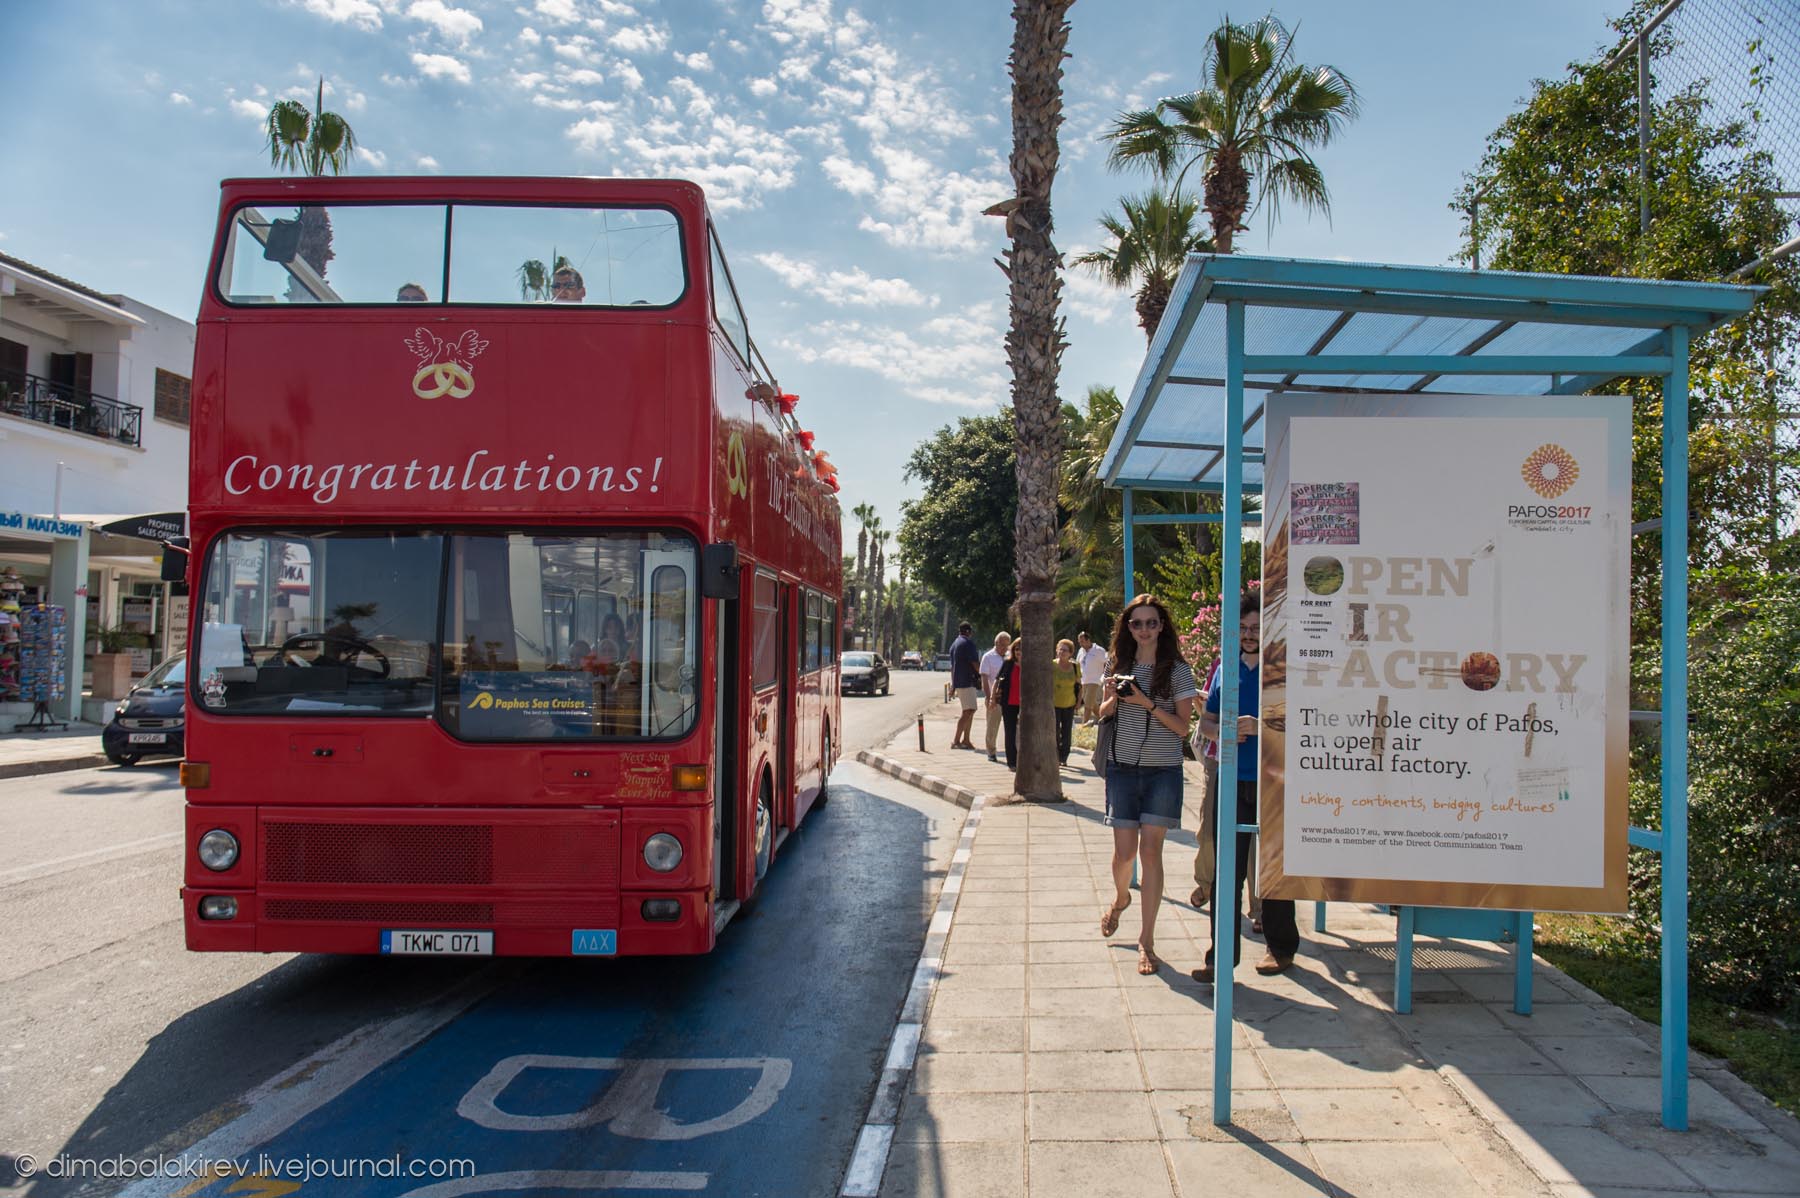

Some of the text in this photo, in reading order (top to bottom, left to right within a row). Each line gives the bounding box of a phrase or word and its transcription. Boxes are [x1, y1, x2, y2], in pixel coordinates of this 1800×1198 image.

[225, 449, 662, 504] Congratulations!
[1508, 505, 1591, 518] PAFOS2017
[27, 517, 82, 537] МАГАЗИН
[138, 526, 157, 538] SALES
[148, 519, 180, 532] PROPERTY
[1303, 555, 1474, 597] OPEN
[1315, 600, 1332, 608] RENT
[1299, 649, 1308, 657] 96
[495, 697, 585, 710] Paphos Sea Cruises
[1300, 708, 1558, 736] The whole city of Pafos,
[1300, 733, 1422, 753] an open air
[1300, 752, 1471, 779] cultural factory.
[1351, 794, 1427, 812] continents,
[1433, 796, 1484, 822] bridging
[1491, 796, 1555, 813] cultures
[1301, 835, 1332, 844] Become
[1343, 837, 1376, 846] member
[1379, 838, 1387, 846] of
[1390, 838, 1403, 847] the
[1406, 839, 1431, 848] Direct
[1433, 840, 1497, 850] Communication
[1500, 842, 1524, 851] Team
[1383, 829, 1509, 841] www.facebook.com/pafos2017
[401, 934, 480, 953] TKWC 071
